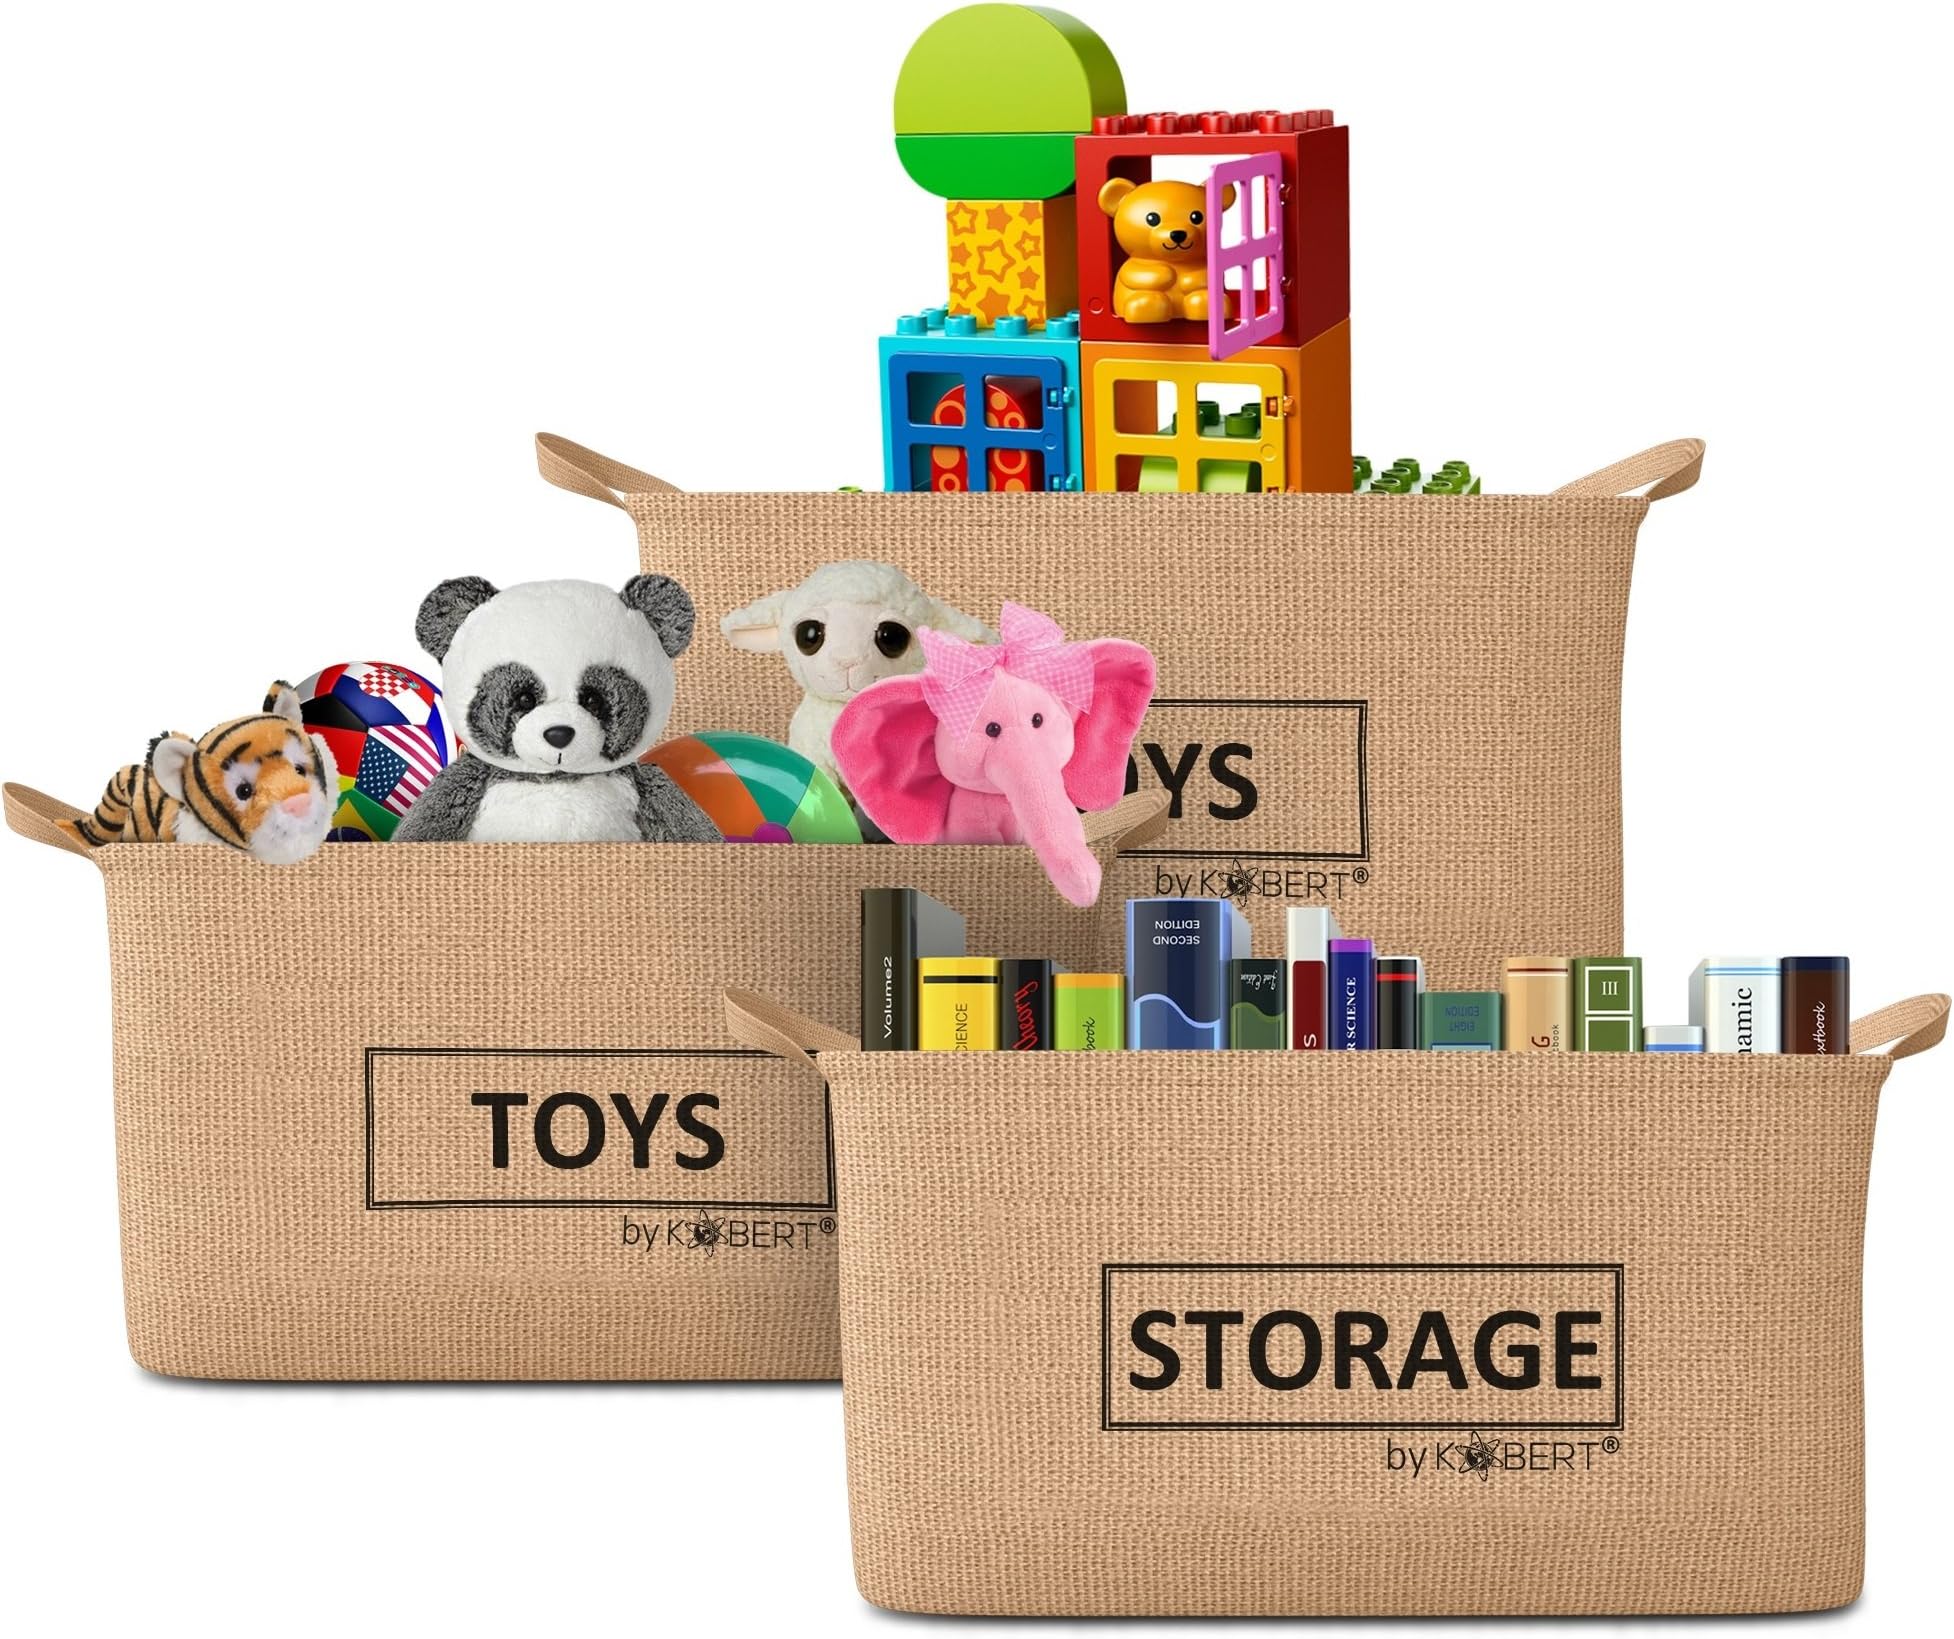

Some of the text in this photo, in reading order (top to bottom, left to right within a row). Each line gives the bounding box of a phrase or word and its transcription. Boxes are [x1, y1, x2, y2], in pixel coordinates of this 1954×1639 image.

[1124, 742, 1258, 820] YS
[1156, 864, 1192, 898] by
[1152, 935, 1201, 945] SECOND
[1154, 920, 1201, 930] EDITION
[883, 956, 893, 1040] Volume2
[1601, 981, 1619, 996] III
[1346, 977, 1356, 1039] SCIENCE
[1445, 1006, 1480, 1017] EDITION
[1448, 1021, 1476, 1032] EIGHT
[1531, 1036, 1550, 1048] G
[471, 1091, 725, 1170] TOYS
[622, 1215, 660, 1251] by
[1129, 1310, 1602, 1391] STORAGE
[1387, 1439, 1427, 1477] by
